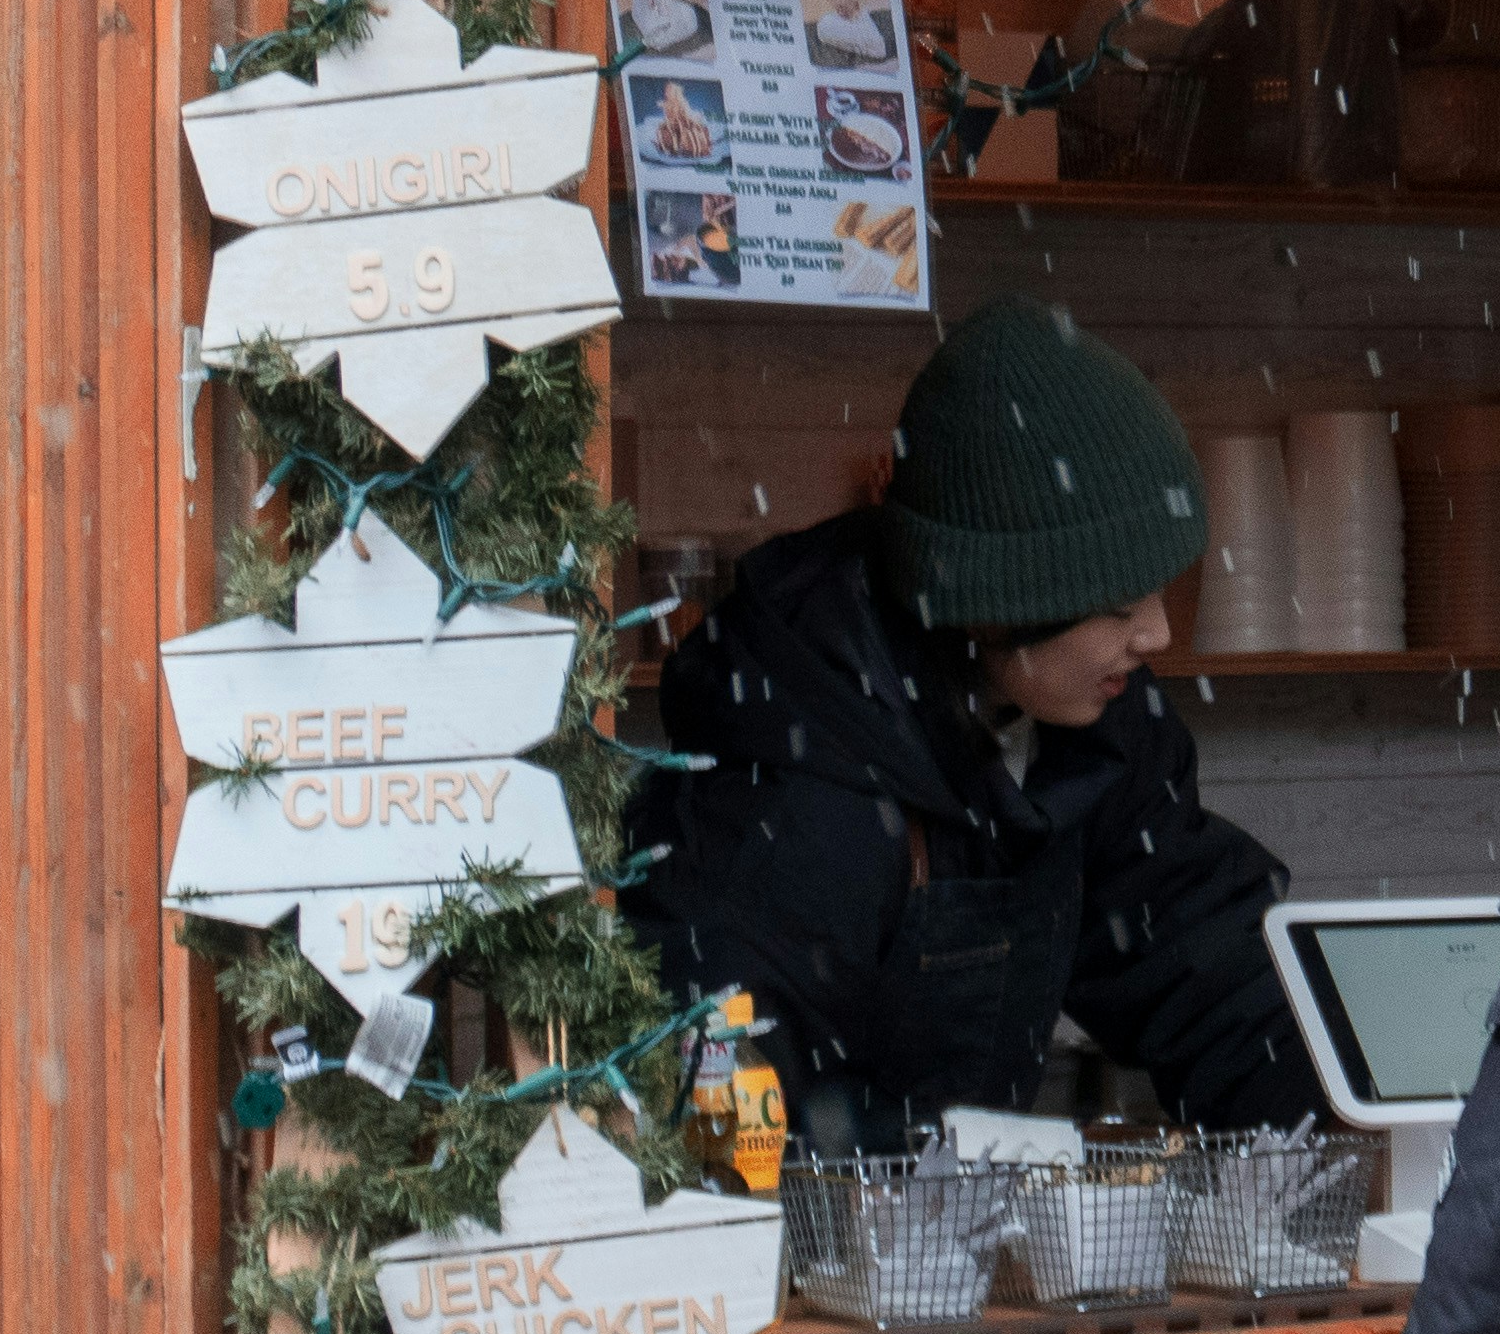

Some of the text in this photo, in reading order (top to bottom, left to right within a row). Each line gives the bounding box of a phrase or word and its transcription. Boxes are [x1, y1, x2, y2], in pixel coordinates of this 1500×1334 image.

[266, 143, 513, 217] ONIGIRI
[346, 246, 455, 322] 5.9
[242, 704, 408, 764] BEEF
[282, 769, 511, 831] CURRY
[402, 1245, 572, 1321] JERK
